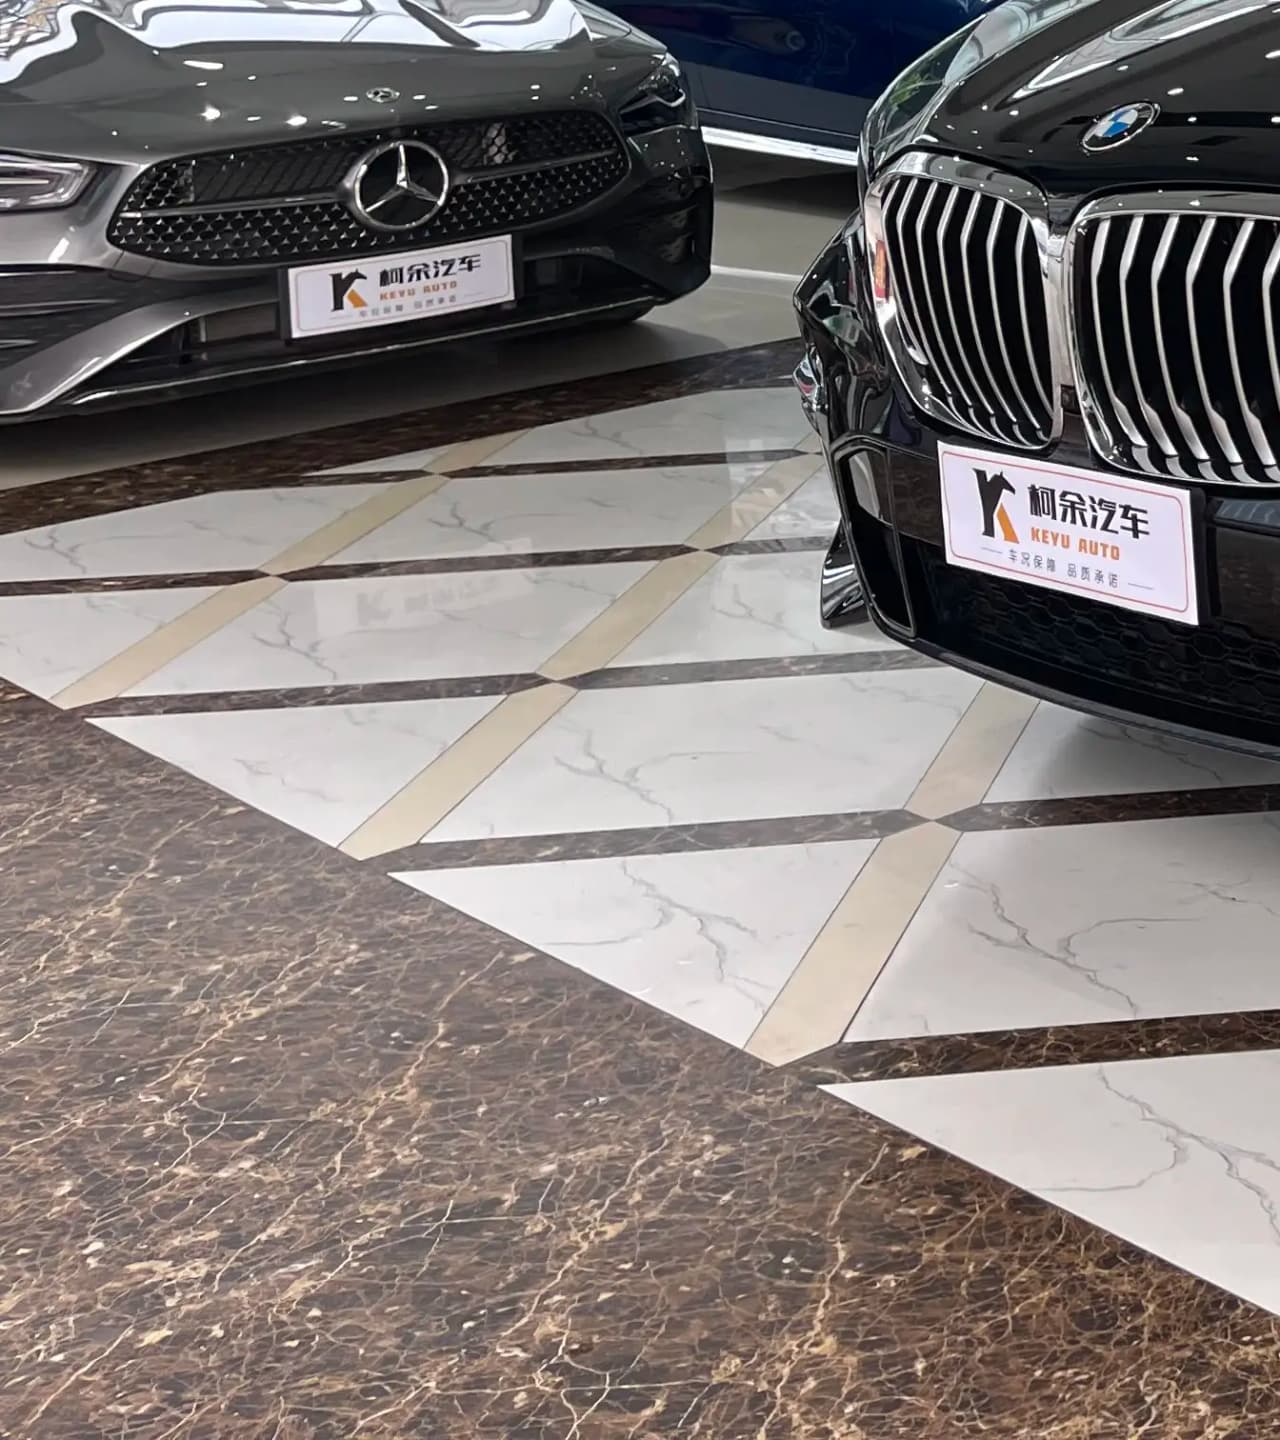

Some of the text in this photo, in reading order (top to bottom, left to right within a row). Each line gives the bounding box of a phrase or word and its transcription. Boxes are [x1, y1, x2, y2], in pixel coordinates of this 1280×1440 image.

[380, 254, 481, 287] 柯余汽车
[380, 280, 457, 301] KEYU AUTO
[1027, 483, 1150, 539] 柯余汽车
[1031, 527, 1120, 561] KEYU AUTO
[1067, 563, 1119, 588] 品质承诺
